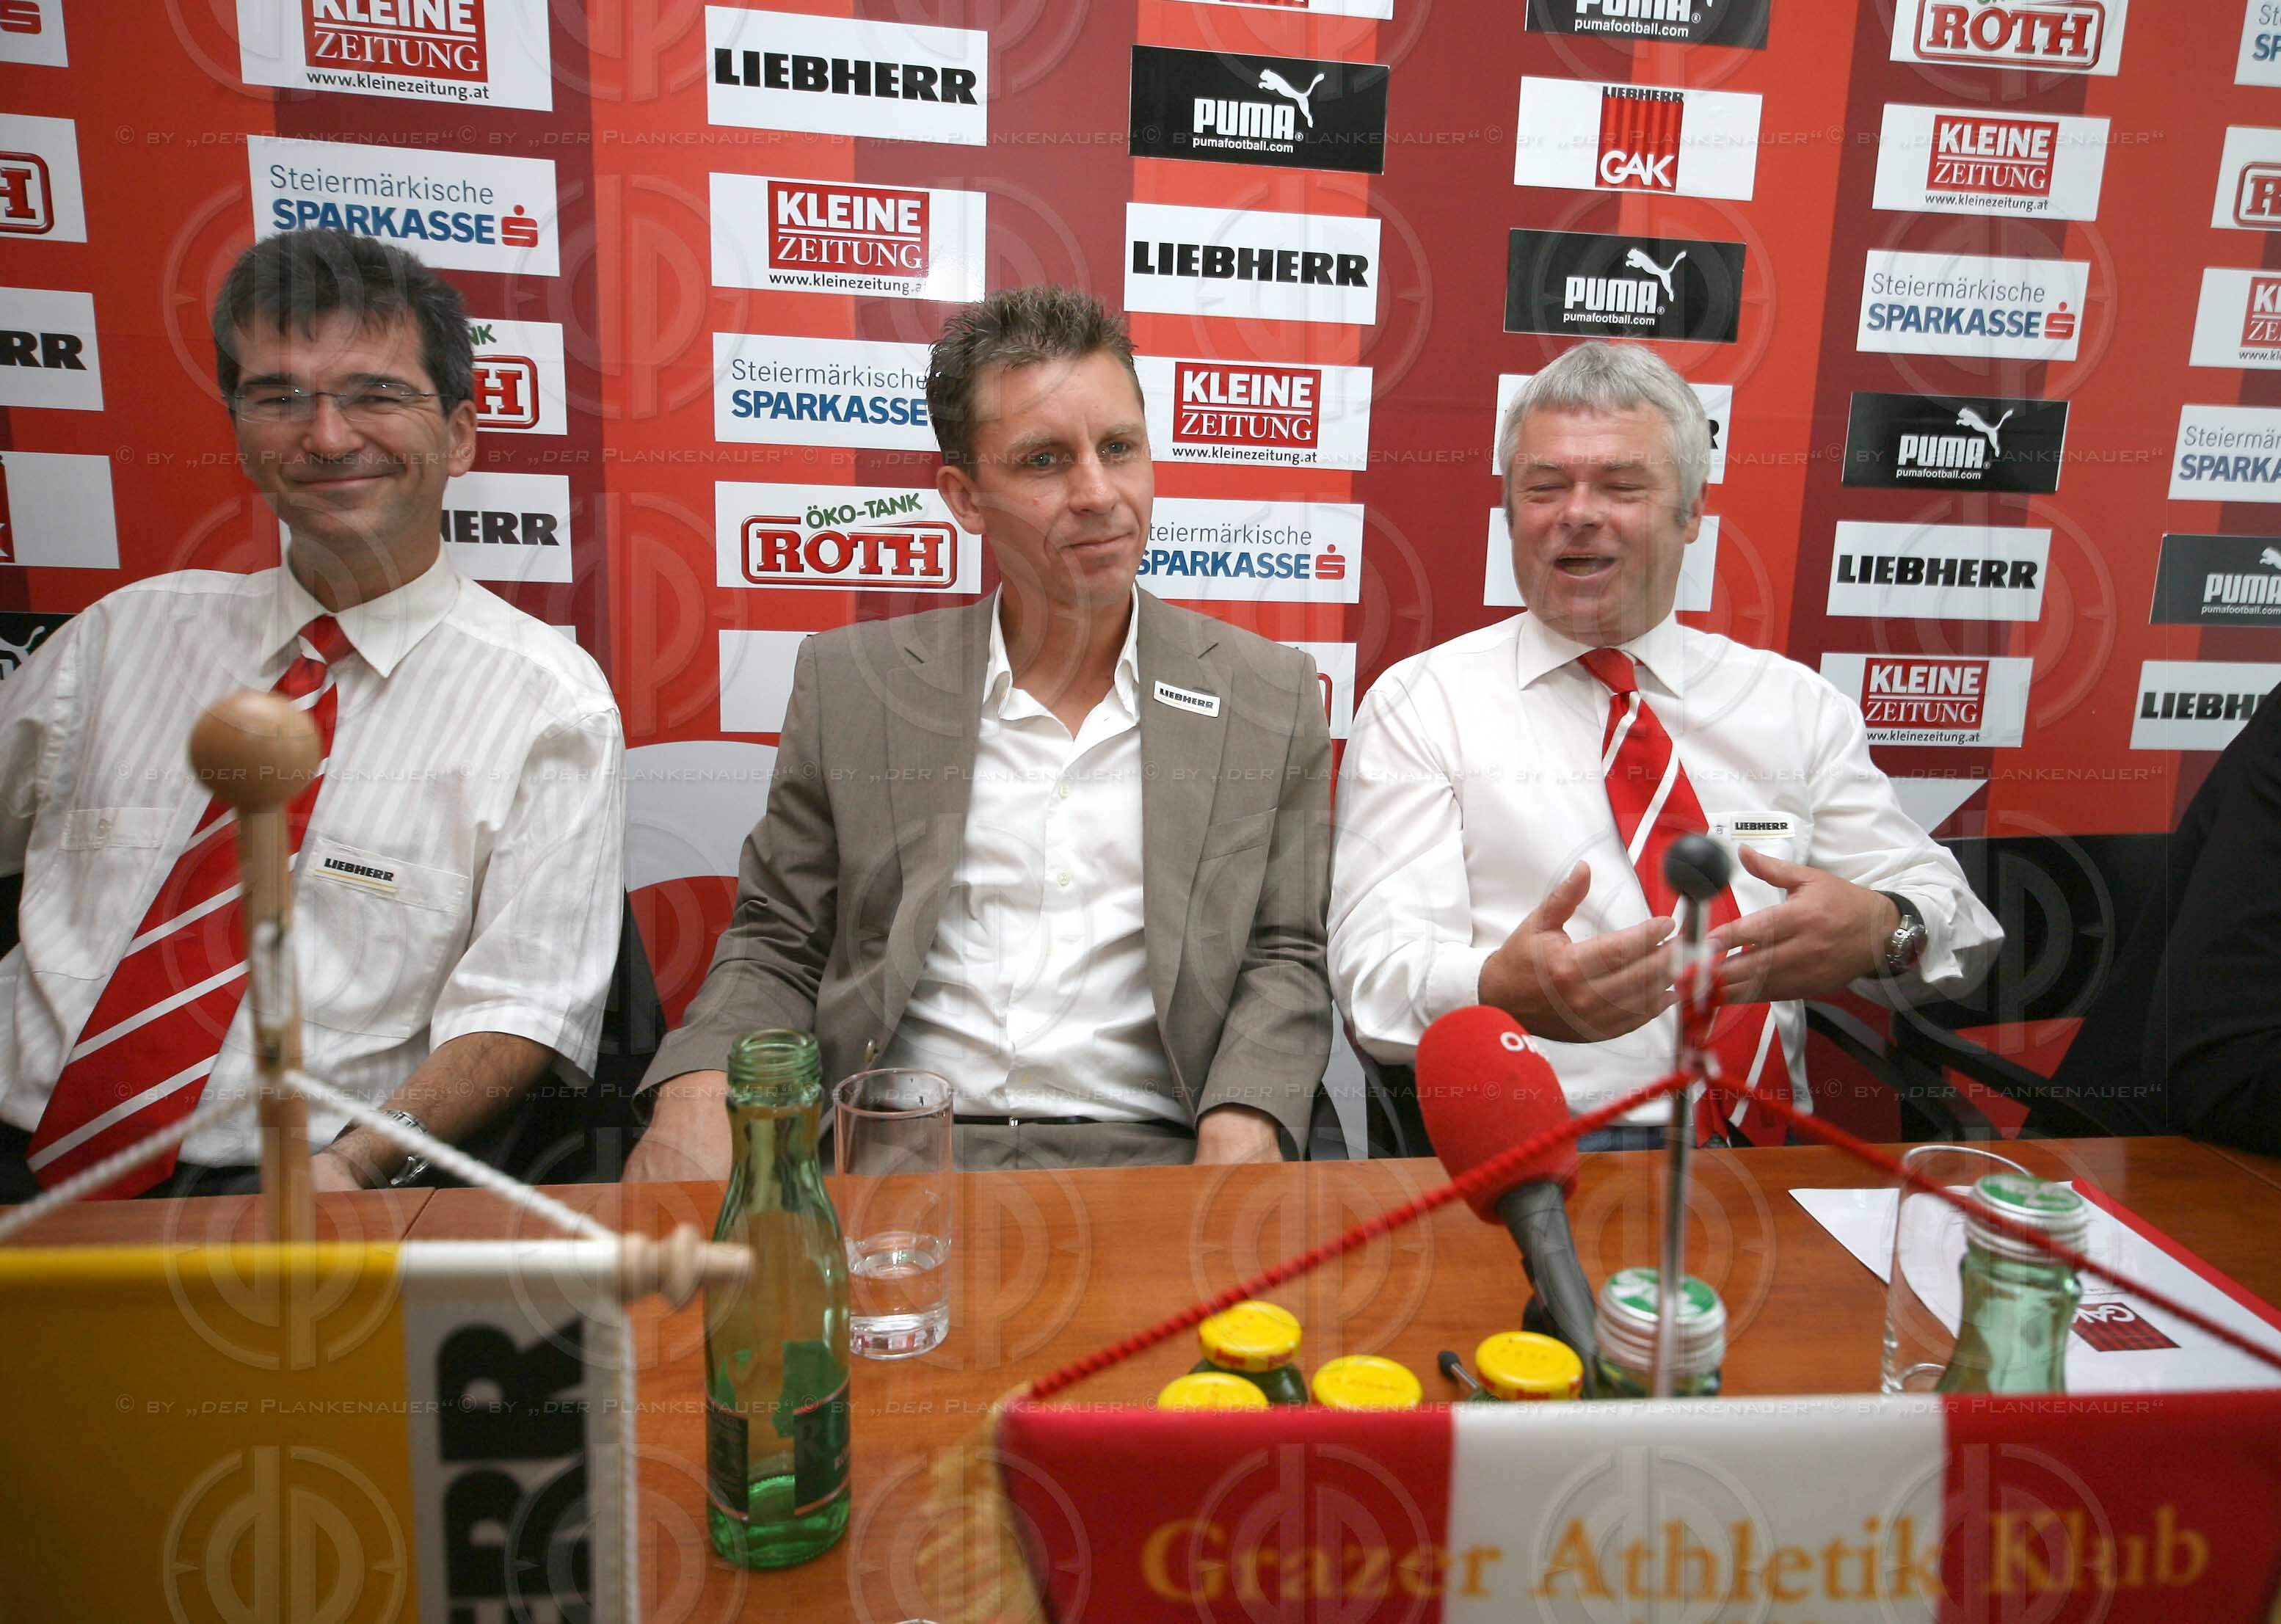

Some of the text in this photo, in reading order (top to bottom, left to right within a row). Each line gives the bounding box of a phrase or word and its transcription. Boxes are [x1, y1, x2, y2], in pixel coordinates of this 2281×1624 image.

[1574, 18, 1689, 37] pumafootball.com
[1927, 4, 2093, 57] ROTH
[314, 30, 479, 72] ZEITUNG
[306, 72, 489, 101] www.kleinezeitung.at
[714, 48, 978, 105] LIEBHERR
[1602, 86, 1684, 104] LIEBHERR
[1193, 98, 1295, 140] PUMA
[1193, 137, 1294, 153] pumafootball.com
[1938, 123, 2051, 159] KLEINE
[270, 164, 494, 205] Steiermärkische
[1600, 150, 1675, 188] GAK
[1933, 161, 2046, 189] ZEITUNG
[776, 191, 922, 234] KLEINE
[1925, 194, 2048, 213] www.kleinezeitung.at
[272, 198, 495, 244] SPARKASSE
[777, 236, 923, 269] ZEITUNG
[1132, 241, 1369, 288] LIEBHERR
[769, 274, 923, 295] www.kleinezeitung.a
[1564, 276, 1658, 314] PUMA
[1871, 272, 2045, 303] Steiermärkische
[1563, 313, 1656, 326] pumafootball.com
[1866, 303, 2042, 338] SPARKASSE
[732, 358, 928, 390] Steiermärkische
[1182, 371, 1314, 409] KLEINE
[731, 389, 928, 426] SPARKASSE
[1180, 412, 1312, 441] ZEITUNG
[1173, 446, 1317, 465] www.kleinezeitung.at
[1897, 435, 1985, 469] PUMA
[1896, 469, 1982, 479] pumafootball.com
[806, 492, 923, 529] ÖKO-TANK
[1149, 522, 1312, 545] teiermärkische
[756, 529, 944, 577] ROTH
[1138, 550, 1311, 580] SPARKASSE
[1836, 554, 2038, 589] LIEBHERR
[1869, 664, 1982, 695] KLEINE
[1160, 688, 1214, 708] LIEBHERR
[1865, 702, 1977, 723] ZEITUNG
[1867, 730, 1980, 745] ww.kleinezeitung.at
[1735, 822, 1789, 830] LIEBHERR
[324, 858, 394, 881] LIEBHERR
[1140, 1505, 2208, 1603] Grazer Athletik Klub
